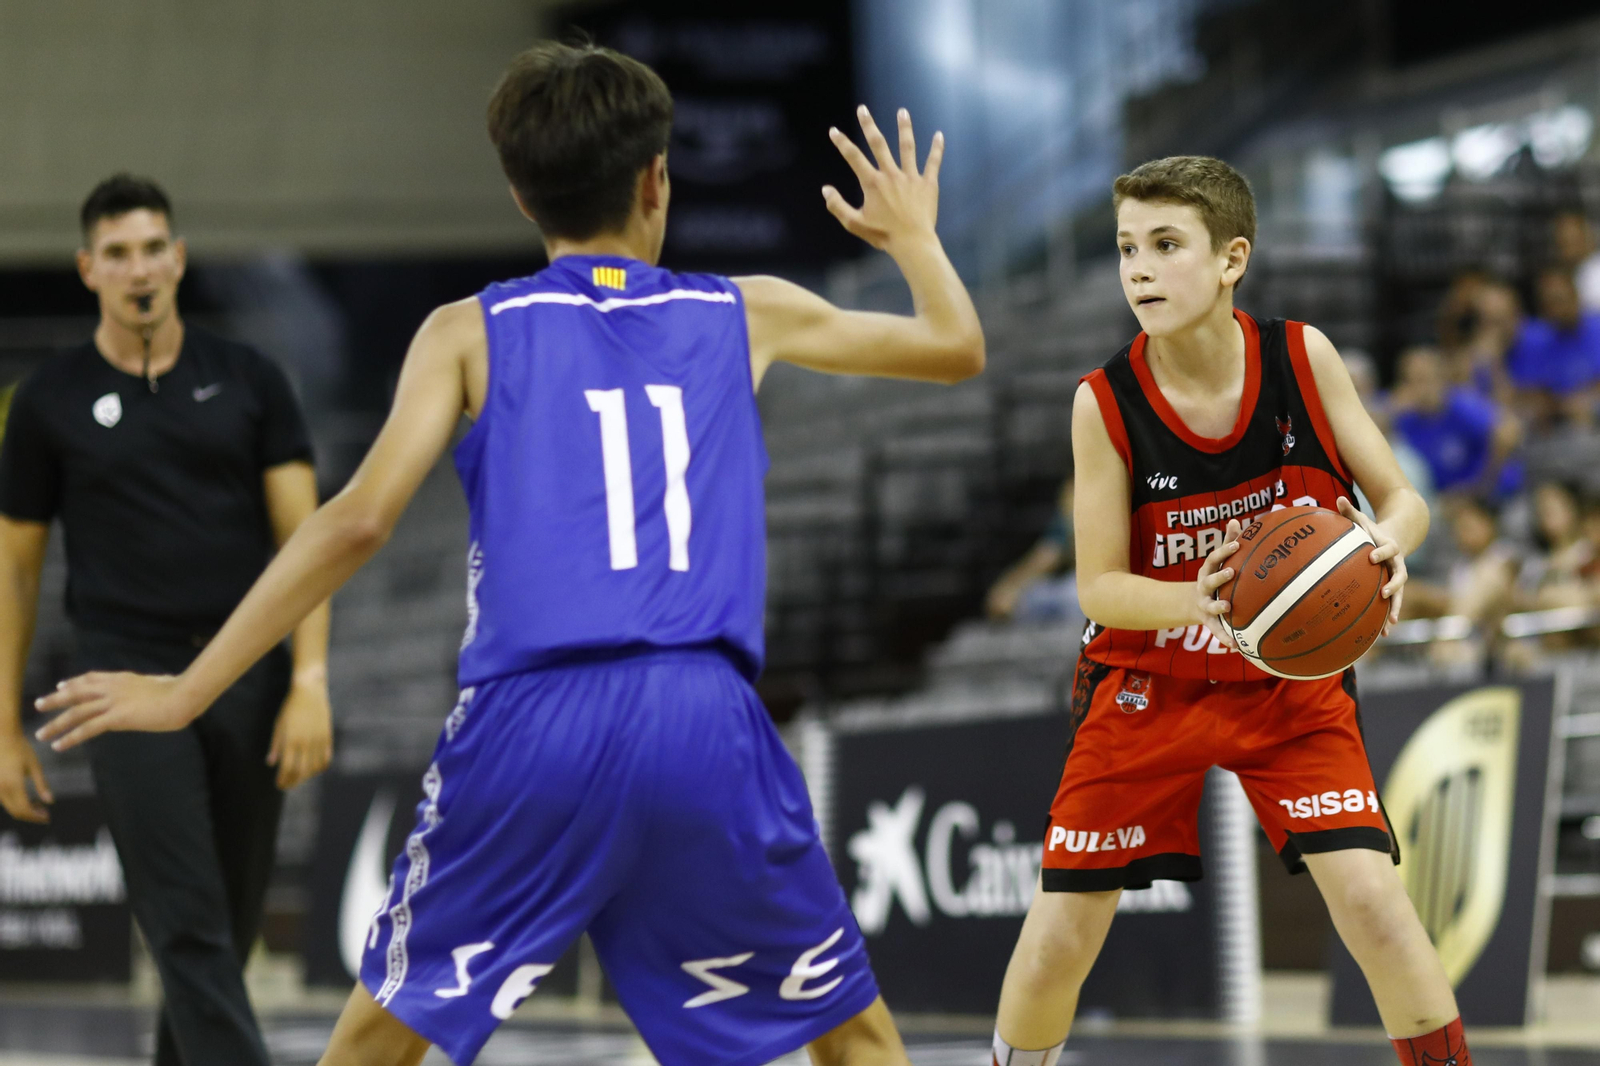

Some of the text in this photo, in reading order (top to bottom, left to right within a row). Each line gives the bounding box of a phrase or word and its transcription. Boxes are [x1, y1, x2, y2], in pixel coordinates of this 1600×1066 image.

[583, 384, 692, 572] 11
[1166, 487, 1272, 528] FUNDACION
[1254, 524, 1316, 580] molten
[1048, 825, 1147, 853] PULEVA
